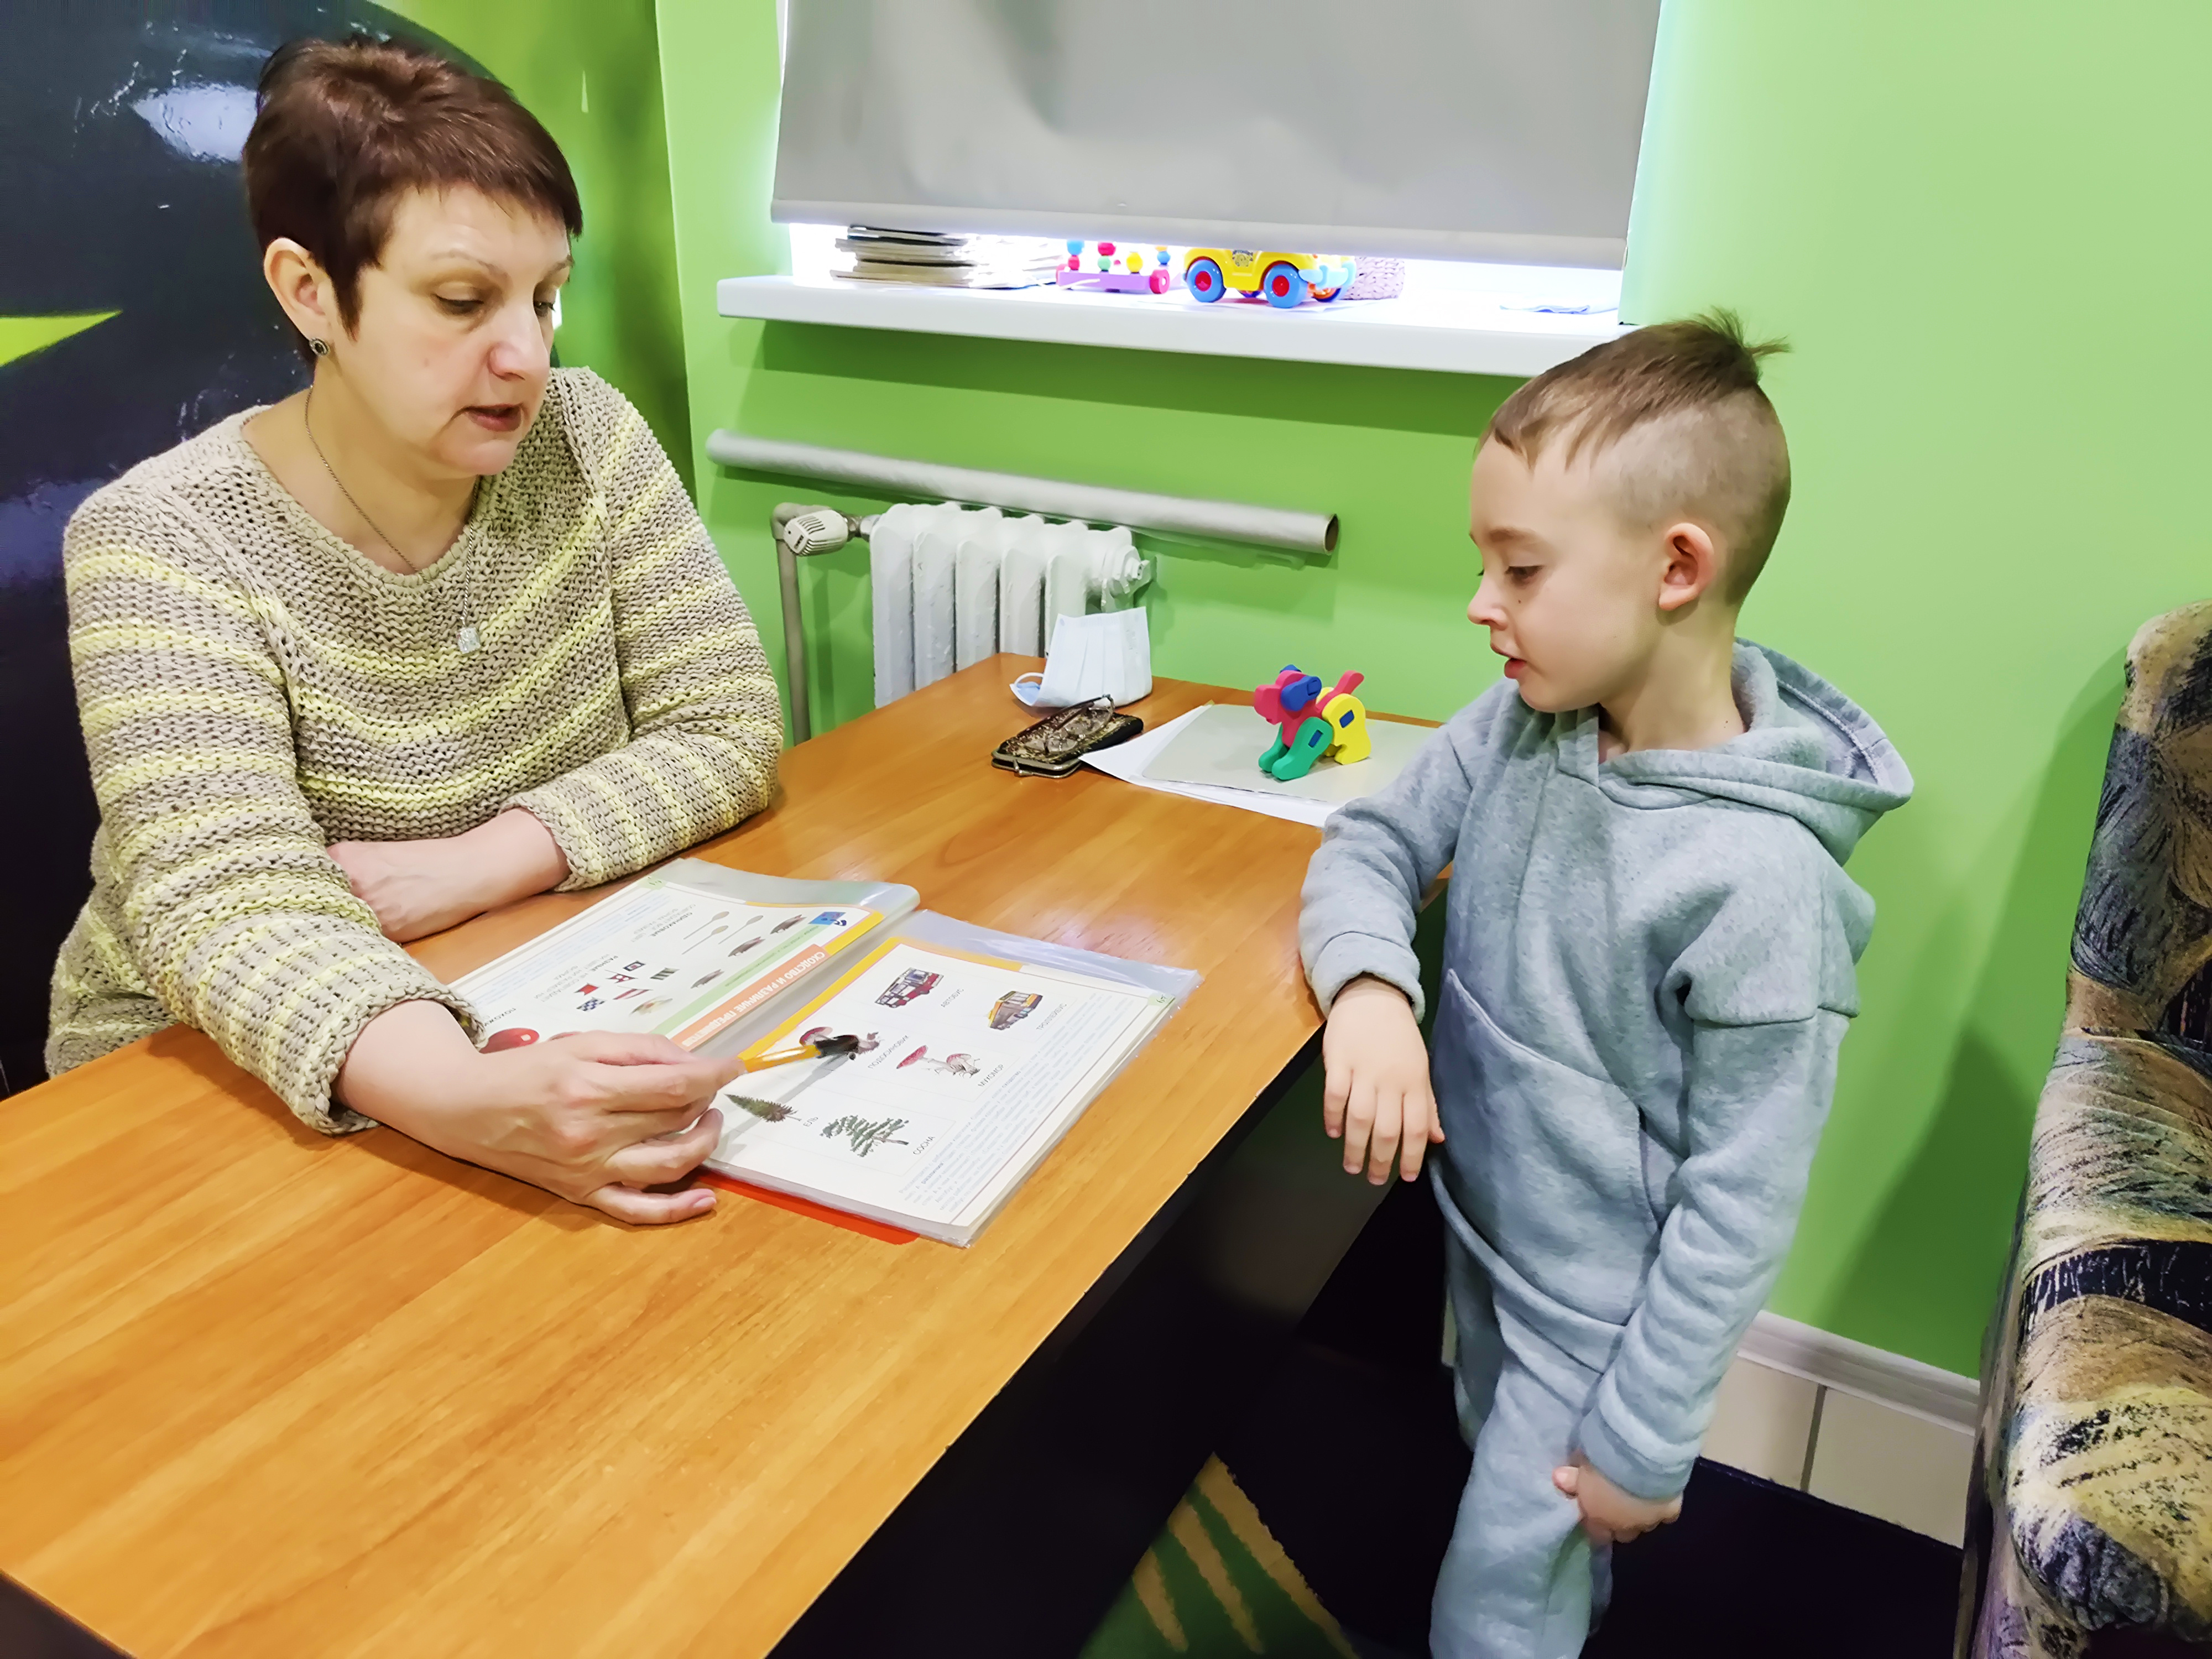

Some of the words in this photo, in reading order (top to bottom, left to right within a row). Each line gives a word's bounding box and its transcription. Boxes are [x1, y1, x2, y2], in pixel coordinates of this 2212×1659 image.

[784, 952, 825, 979] СХОДСТВО
[776, 977, 786, 985] И
[734, 982, 779, 1013] РАЗЛИЧИЕ
[940, 988, 964, 1008] АВТОБУС
[1036, 1003, 1067, 1030] ТРОЛЛЕЙБУС
[868, 1035, 909, 1068] ПОДОСИНОВИК
[978, 1064, 1004, 1087] МУХОМОР
[803, 1117, 818, 1127] ЕЛЬ
[912, 1136, 935, 1155] СОСНА
